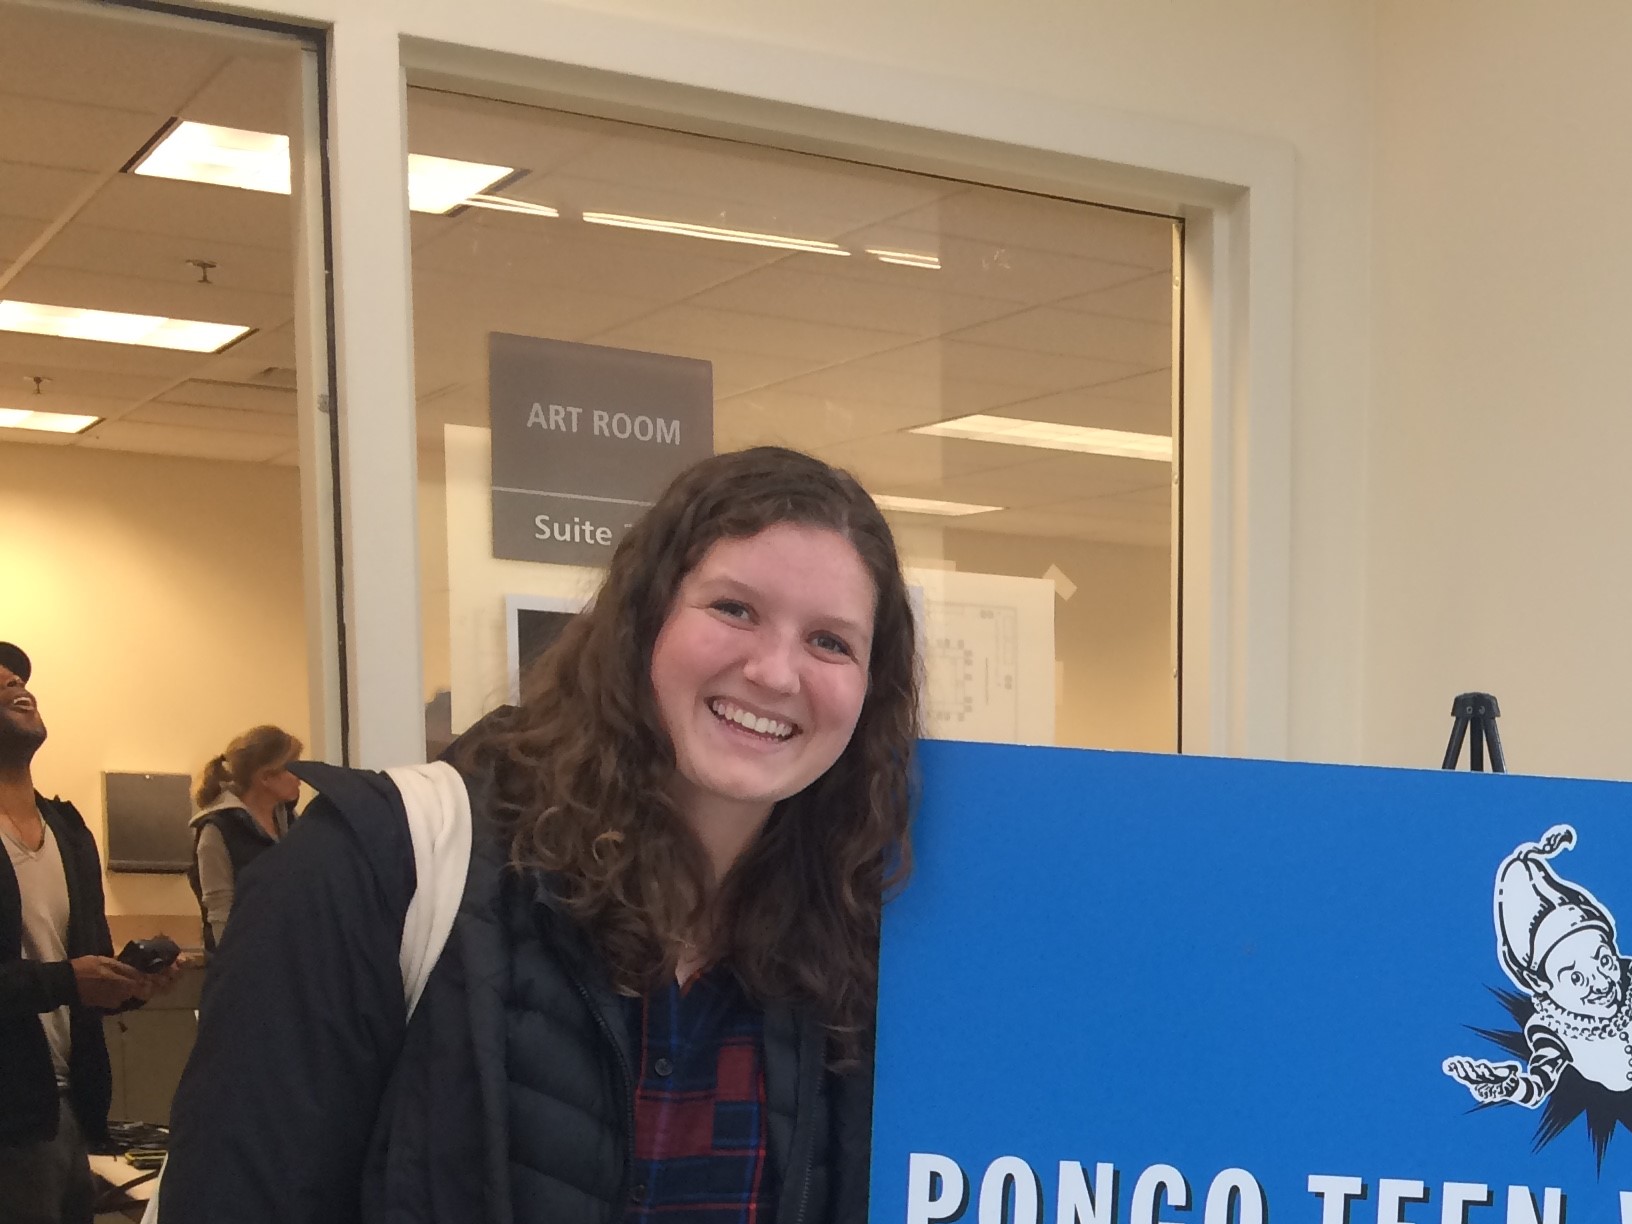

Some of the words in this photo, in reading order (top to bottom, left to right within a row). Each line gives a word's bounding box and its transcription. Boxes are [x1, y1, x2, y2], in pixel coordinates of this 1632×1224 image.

[527, 403, 582, 432] ART
[593, 410, 680, 445] ROOM
[535, 514, 612, 546] Suite
